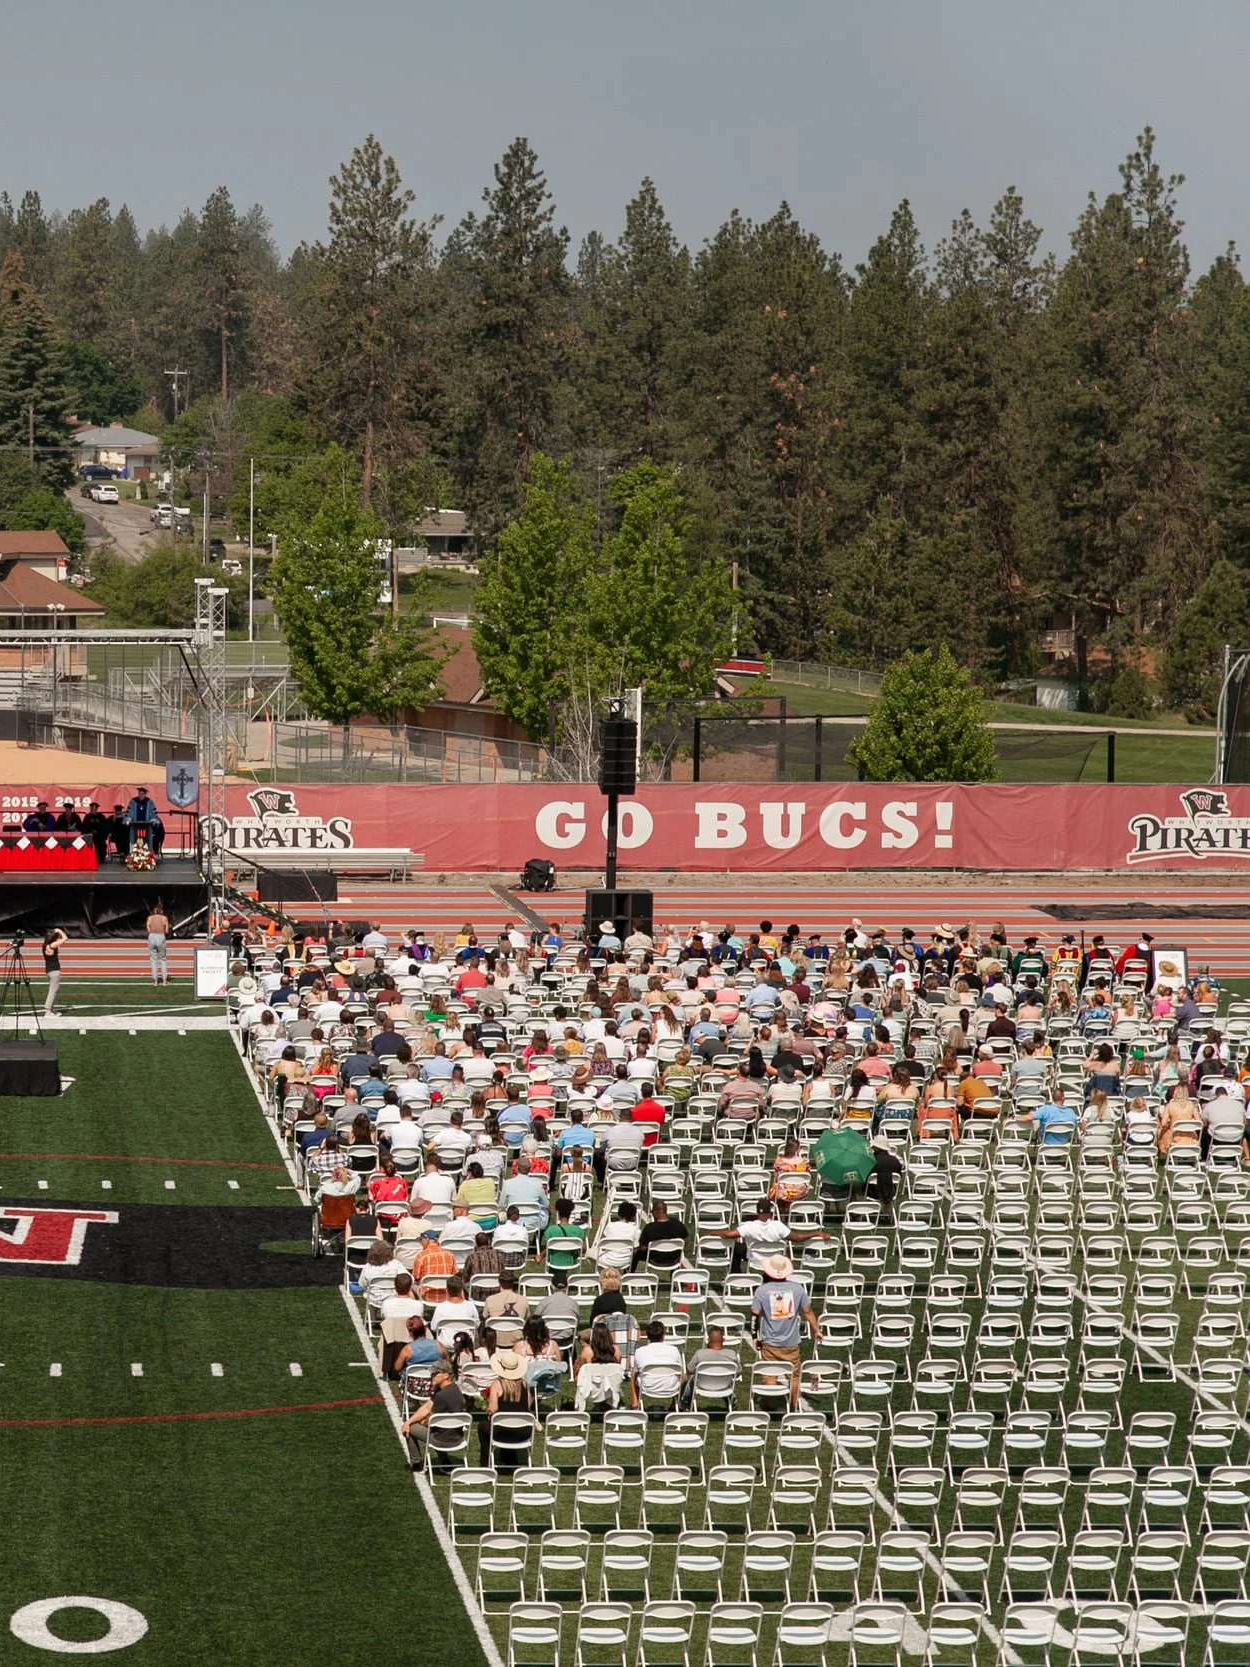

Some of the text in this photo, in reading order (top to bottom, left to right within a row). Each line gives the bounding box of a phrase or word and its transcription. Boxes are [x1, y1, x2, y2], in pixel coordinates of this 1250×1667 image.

[2, 796, 39, 808] 2015
[258, 794, 280, 809] W
[1190, 794, 1212, 810] W
[199, 816, 351, 850] PIRATES
[535, 801, 954, 849] GO BUCS!
